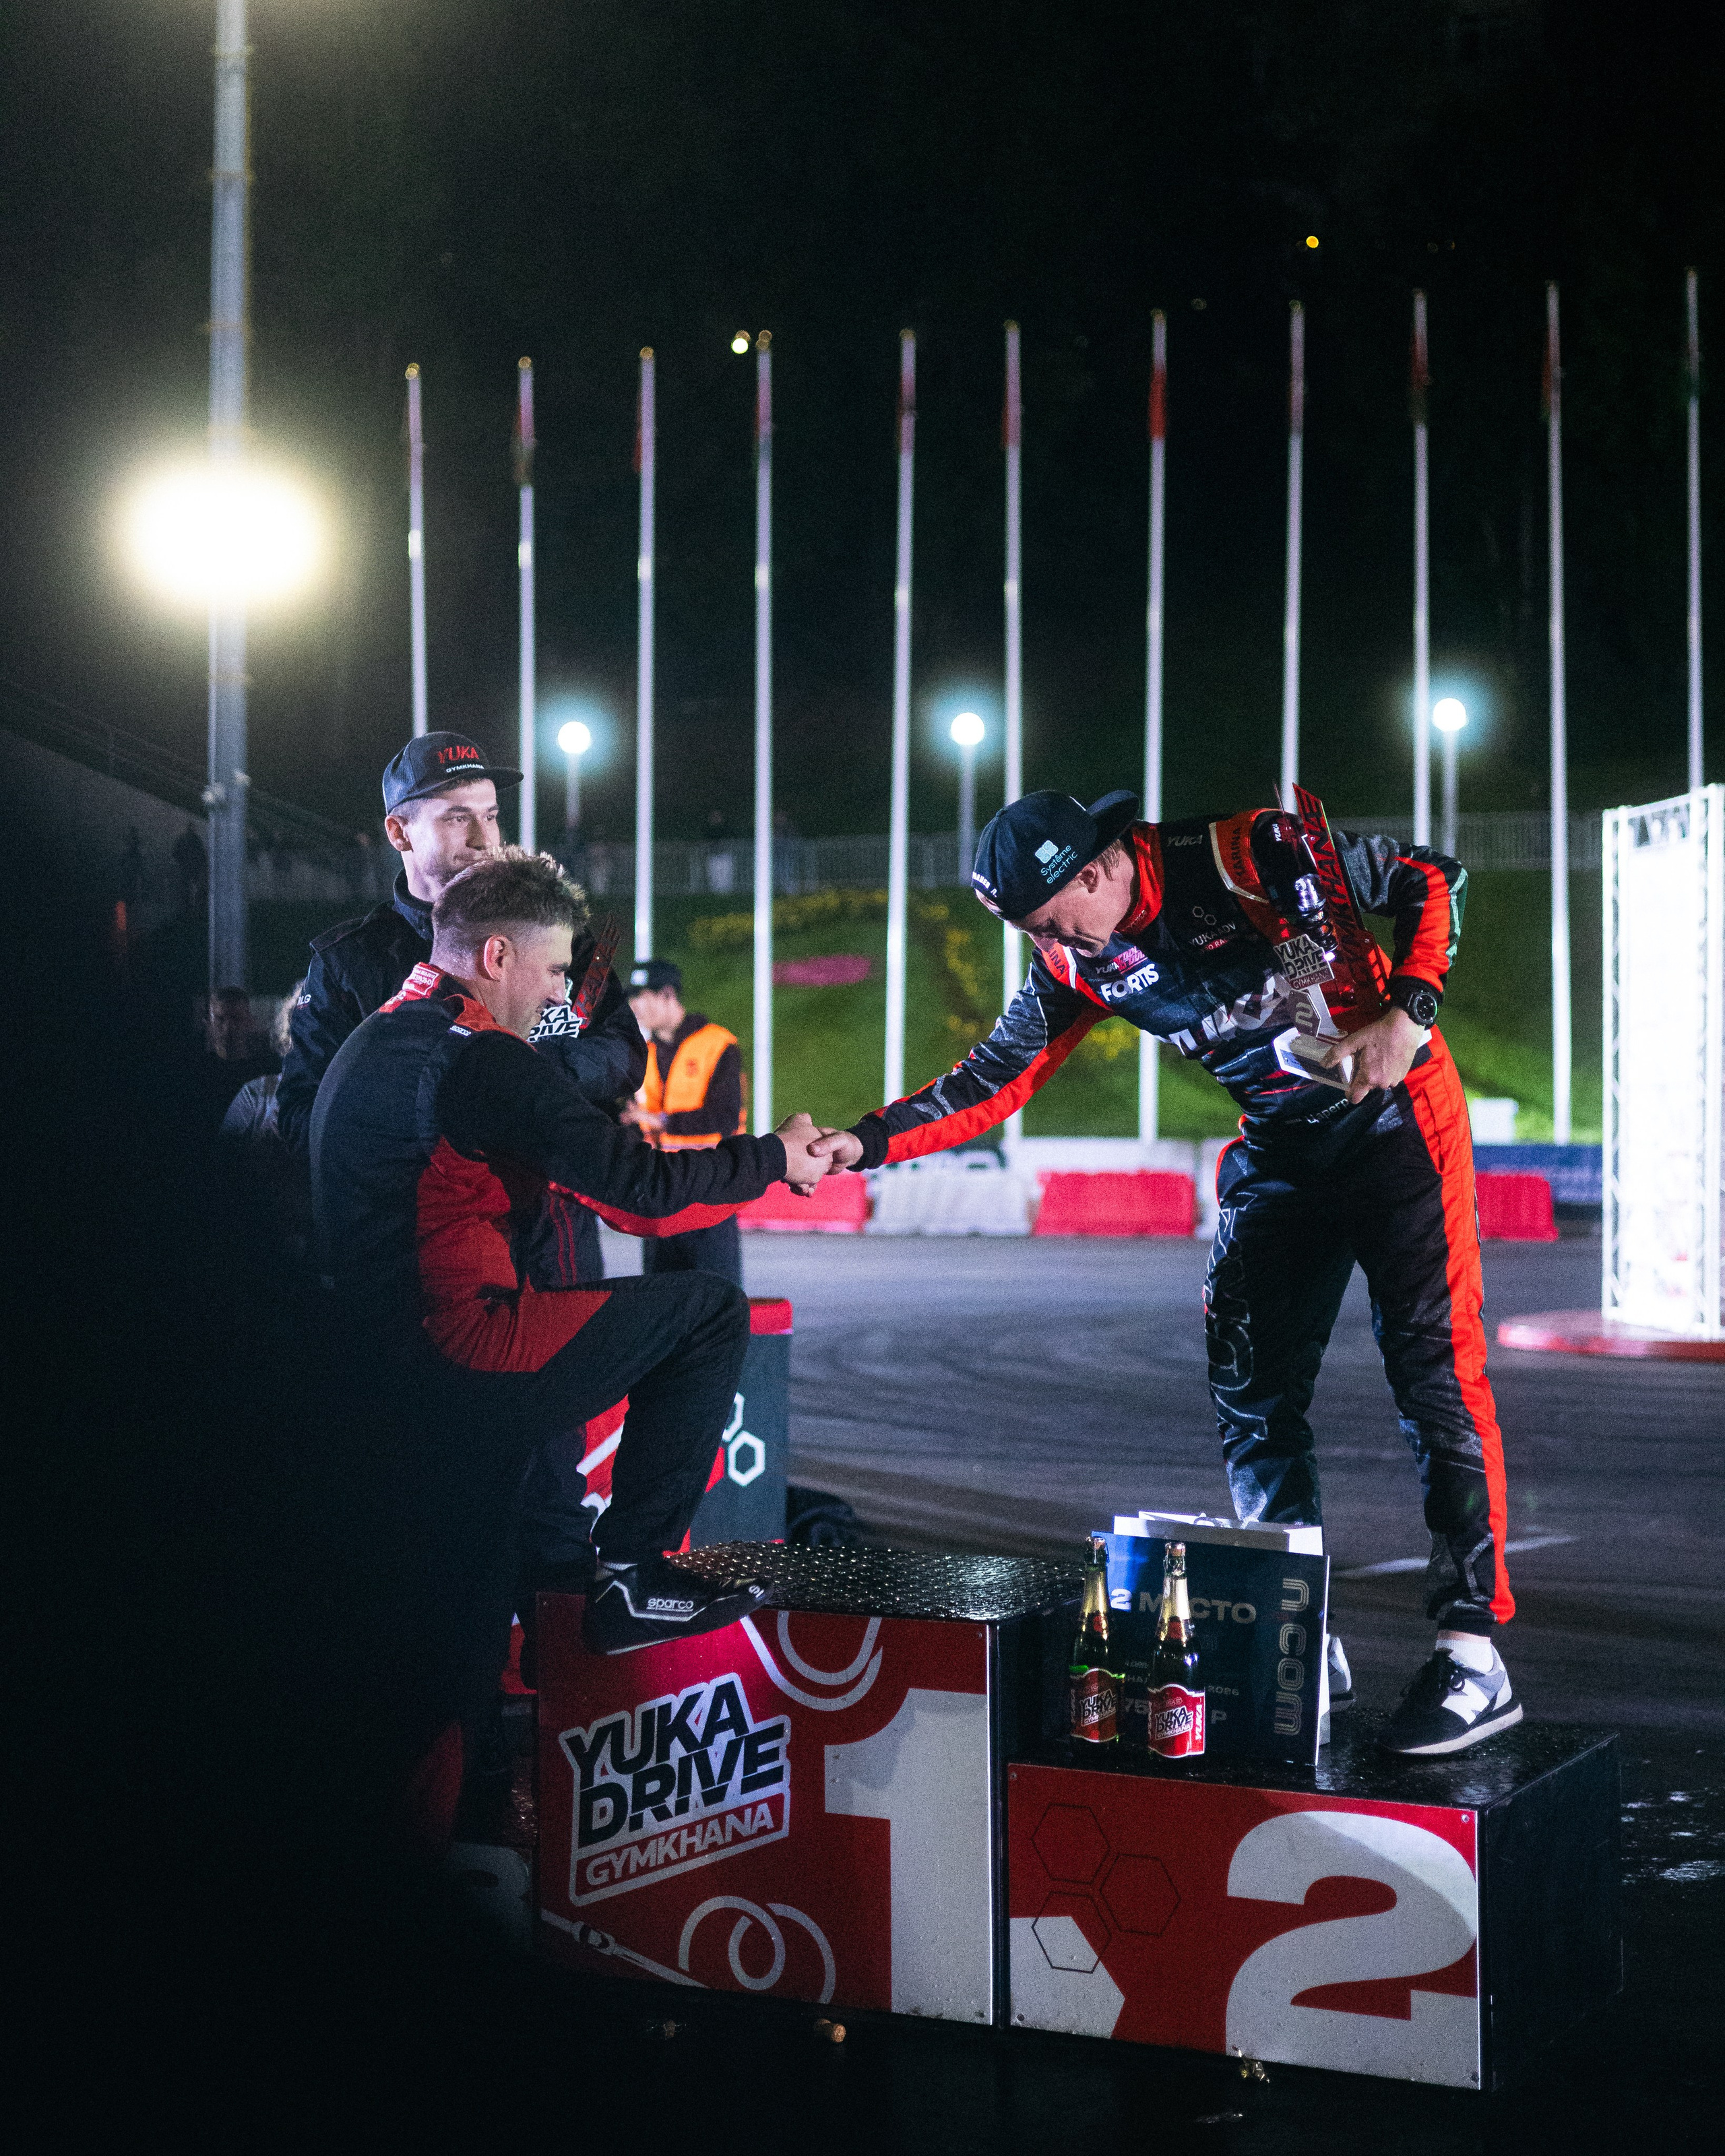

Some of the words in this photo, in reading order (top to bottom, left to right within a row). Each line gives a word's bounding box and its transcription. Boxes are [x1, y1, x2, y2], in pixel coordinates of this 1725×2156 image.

[438, 745, 479, 764] YUKA
[445, 763, 484, 773] GYMKHANA
[1166, 834, 1203, 848] YUKA
[1272, 823, 1282, 842] YUKA
[1046, 851, 1078, 884] electric
[1189, 931, 1218, 947] YUKA
[1277, 936, 1313, 962] YUKA
[1048, 949, 1065, 976] INA
[1283, 949, 1325, 979] DRIVE
[1100, 963, 1159, 1002] FORTIS
[1292, 968, 1329, 989] GYMKHANA
[540, 1007, 569, 1024] KA
[1294, 1001, 1314, 1027] 2
[529, 1020, 580, 1042] RIVE
[647, 1597, 694, 1610] sparco
[1110, 1588, 1132, 1610] 2
[1139, 1591, 1257, 1624] МСТО
[1080, 1690, 1112, 1709] YUKA
[1083, 1698, 1117, 1717] DRIVE
[1156, 1707, 1187, 1723] YUKA
[1157, 1713, 1193, 1732] DRIVE
[565, 1680, 750, 1791] YUKA
[578, 1723, 784, 1849] DRIVE
[586, 1802, 774, 1886] GYMKHANA
[825, 1688, 992, 2025] 1
[1226, 1810, 1480, 2089] 2
